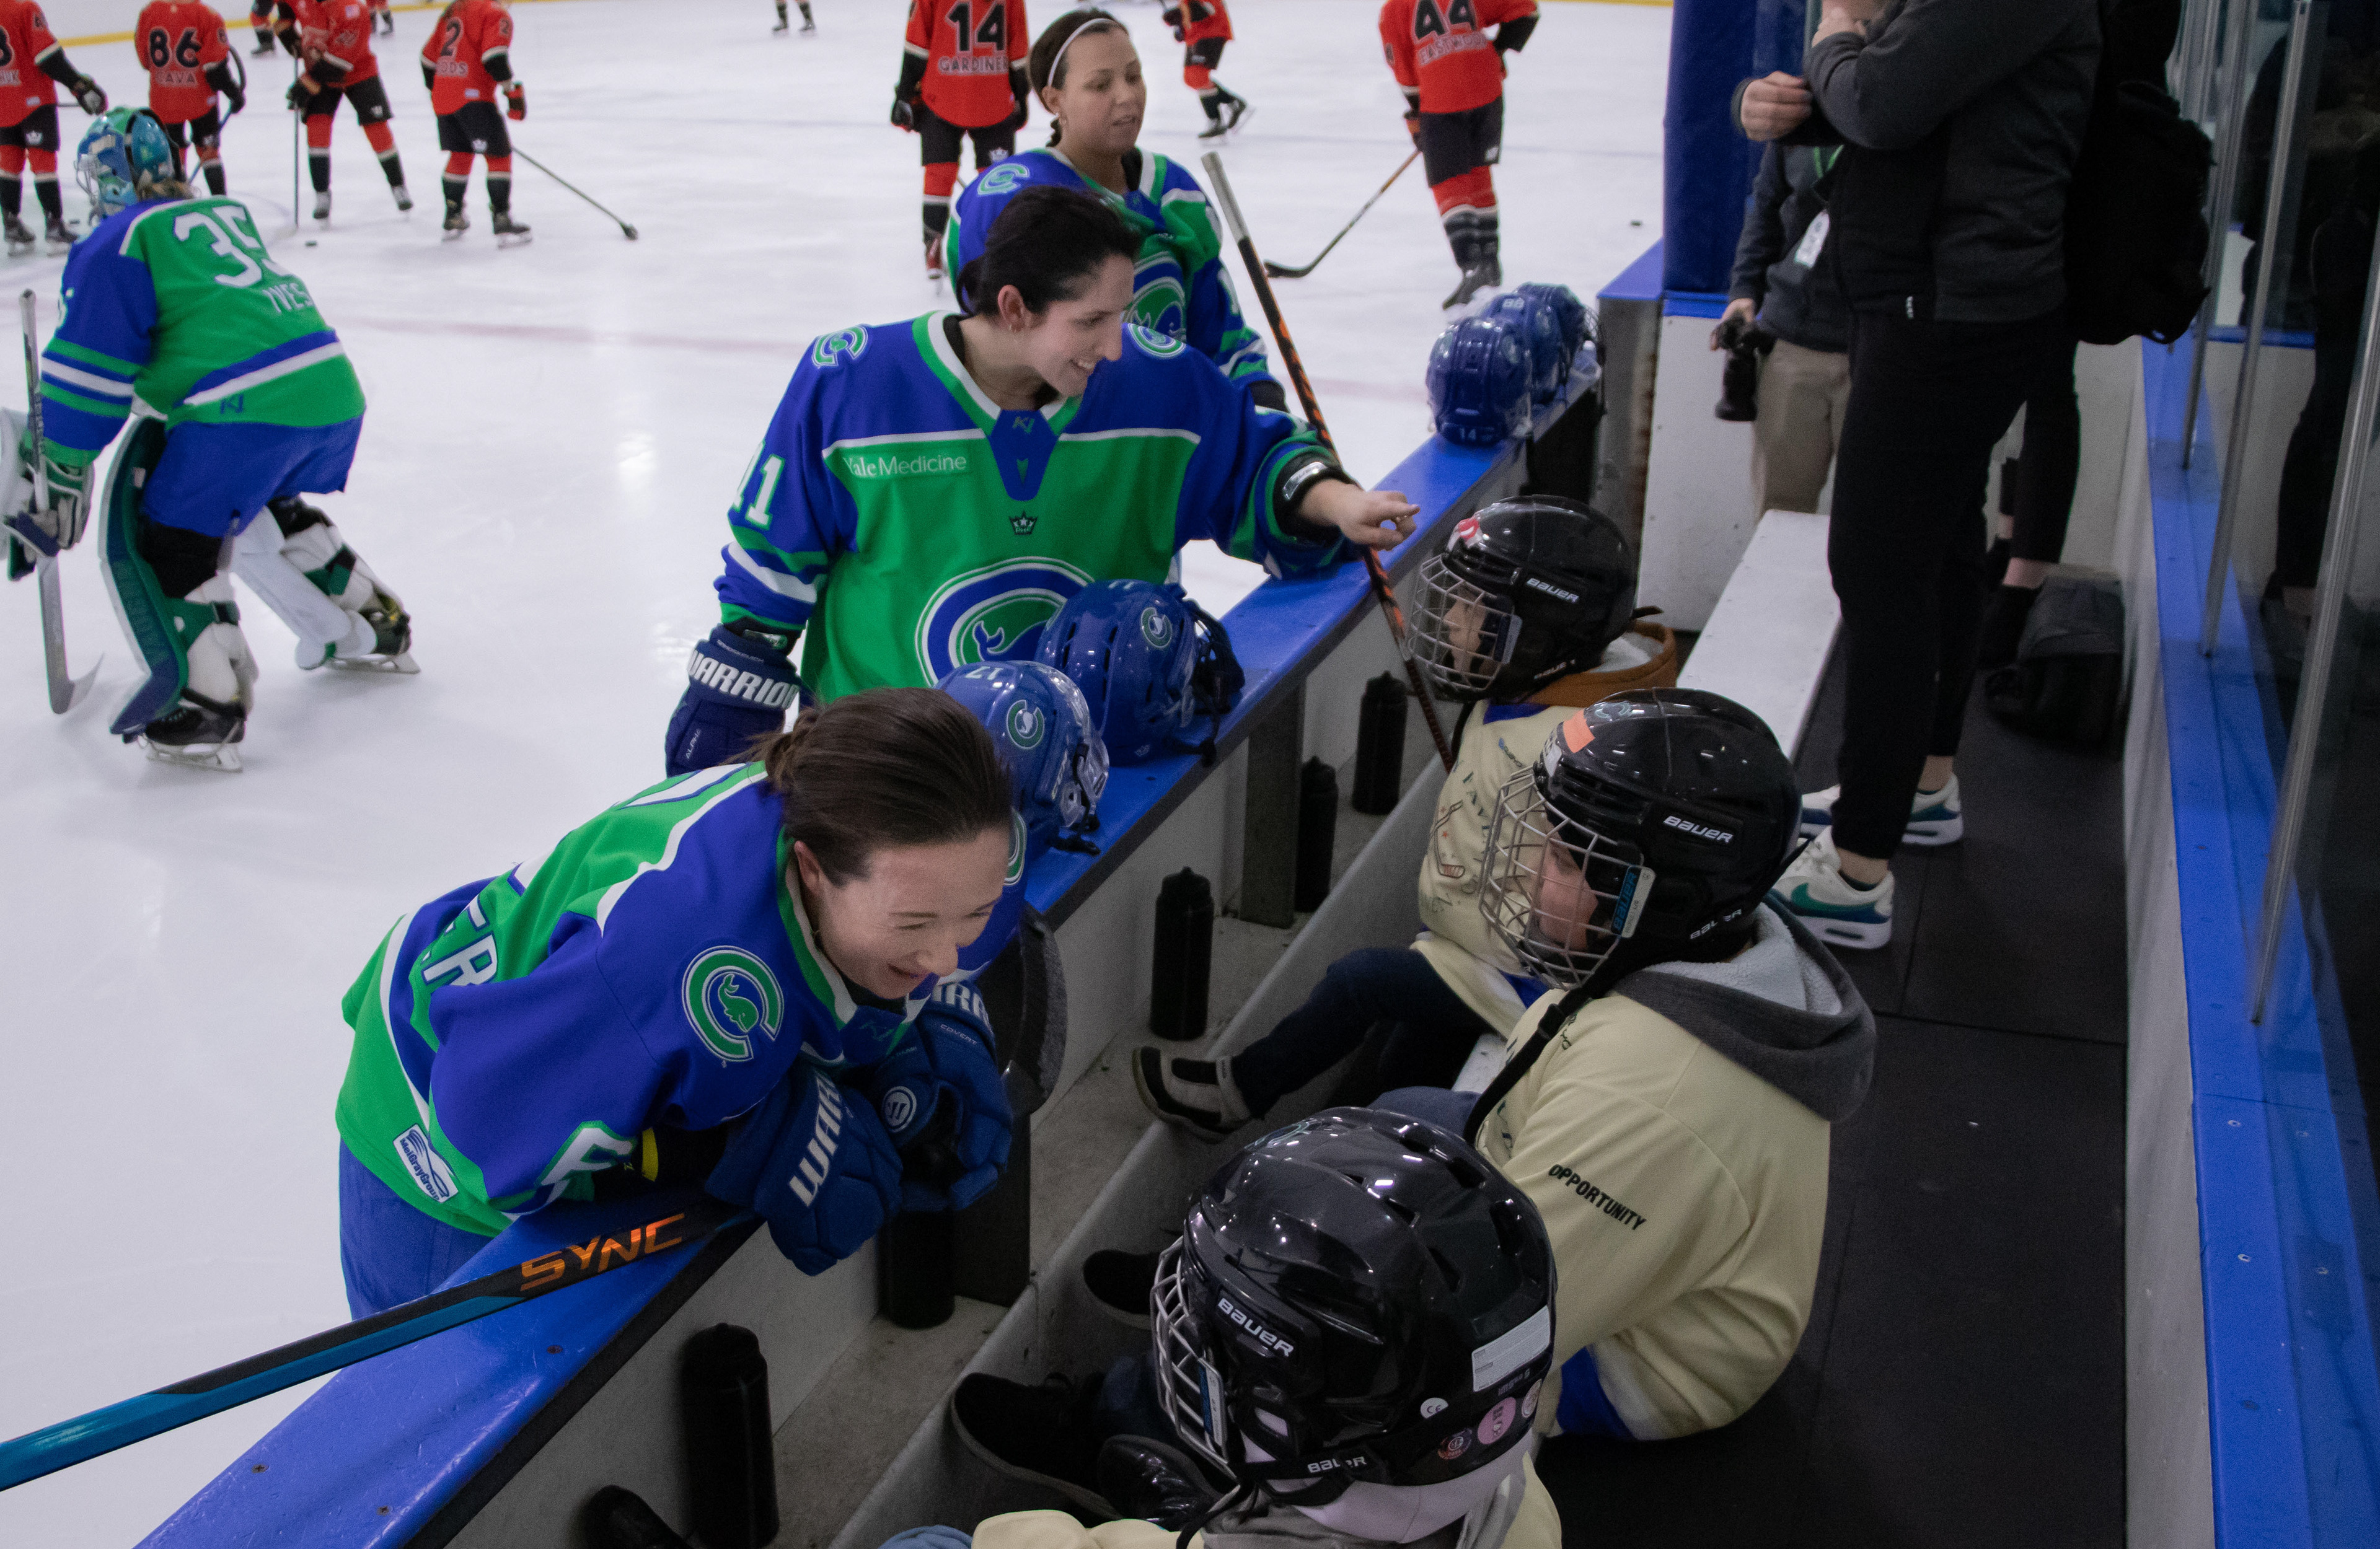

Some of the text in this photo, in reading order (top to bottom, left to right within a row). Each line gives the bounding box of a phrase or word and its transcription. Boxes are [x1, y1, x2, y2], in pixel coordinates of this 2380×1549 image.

[439, 17, 464, 61] 2
[945, 0, 1007, 54] 14
[1413, 0, 1478, 43] 44
[149, 27, 202, 68] 86
[174, 204, 302, 288] 35
[878, 454, 967, 476] Medicine
[1526, 577, 1580, 603] BAUER
[1533, 659, 1576, 680] BAUE
[685, 728, 701, 760] ALPHA
[1663, 815, 1734, 843] BAUER
[940, 1024, 977, 1045] COVERT
[1548, 1164, 1647, 1231] OPPORTUNITY
[520, 1213, 685, 1291] SYNC
[1217, 1297, 1295, 1358] BAUER
